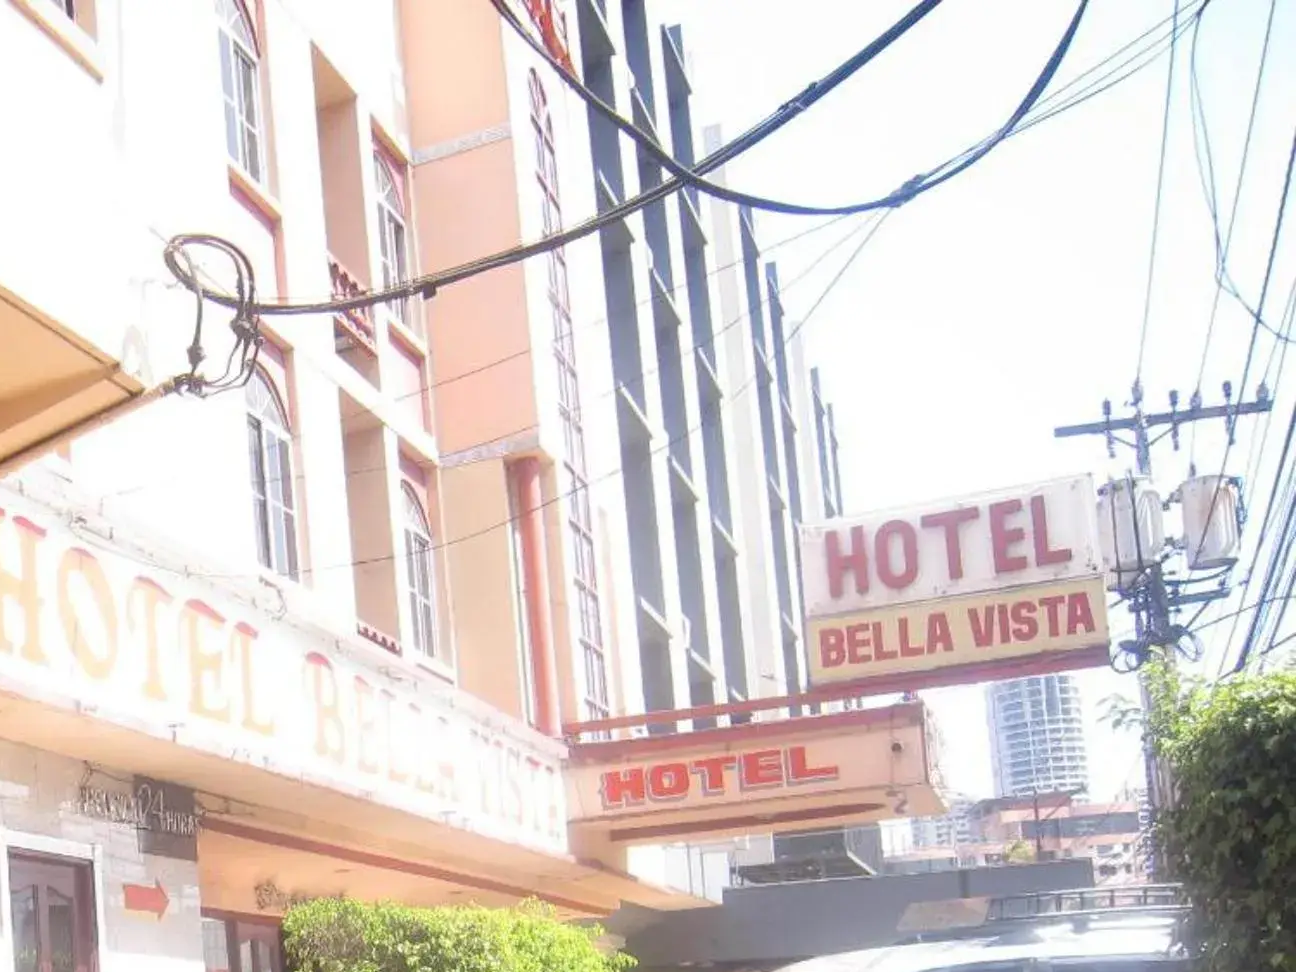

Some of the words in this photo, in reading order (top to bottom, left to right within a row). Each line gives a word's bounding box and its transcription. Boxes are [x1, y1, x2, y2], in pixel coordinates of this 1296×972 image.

[825, 495, 1073, 599] HOTEL
[819, 612, 954, 669] BELLA
[967, 591, 1097, 648] VISTA
[603, 746, 837, 808] HOTEL
